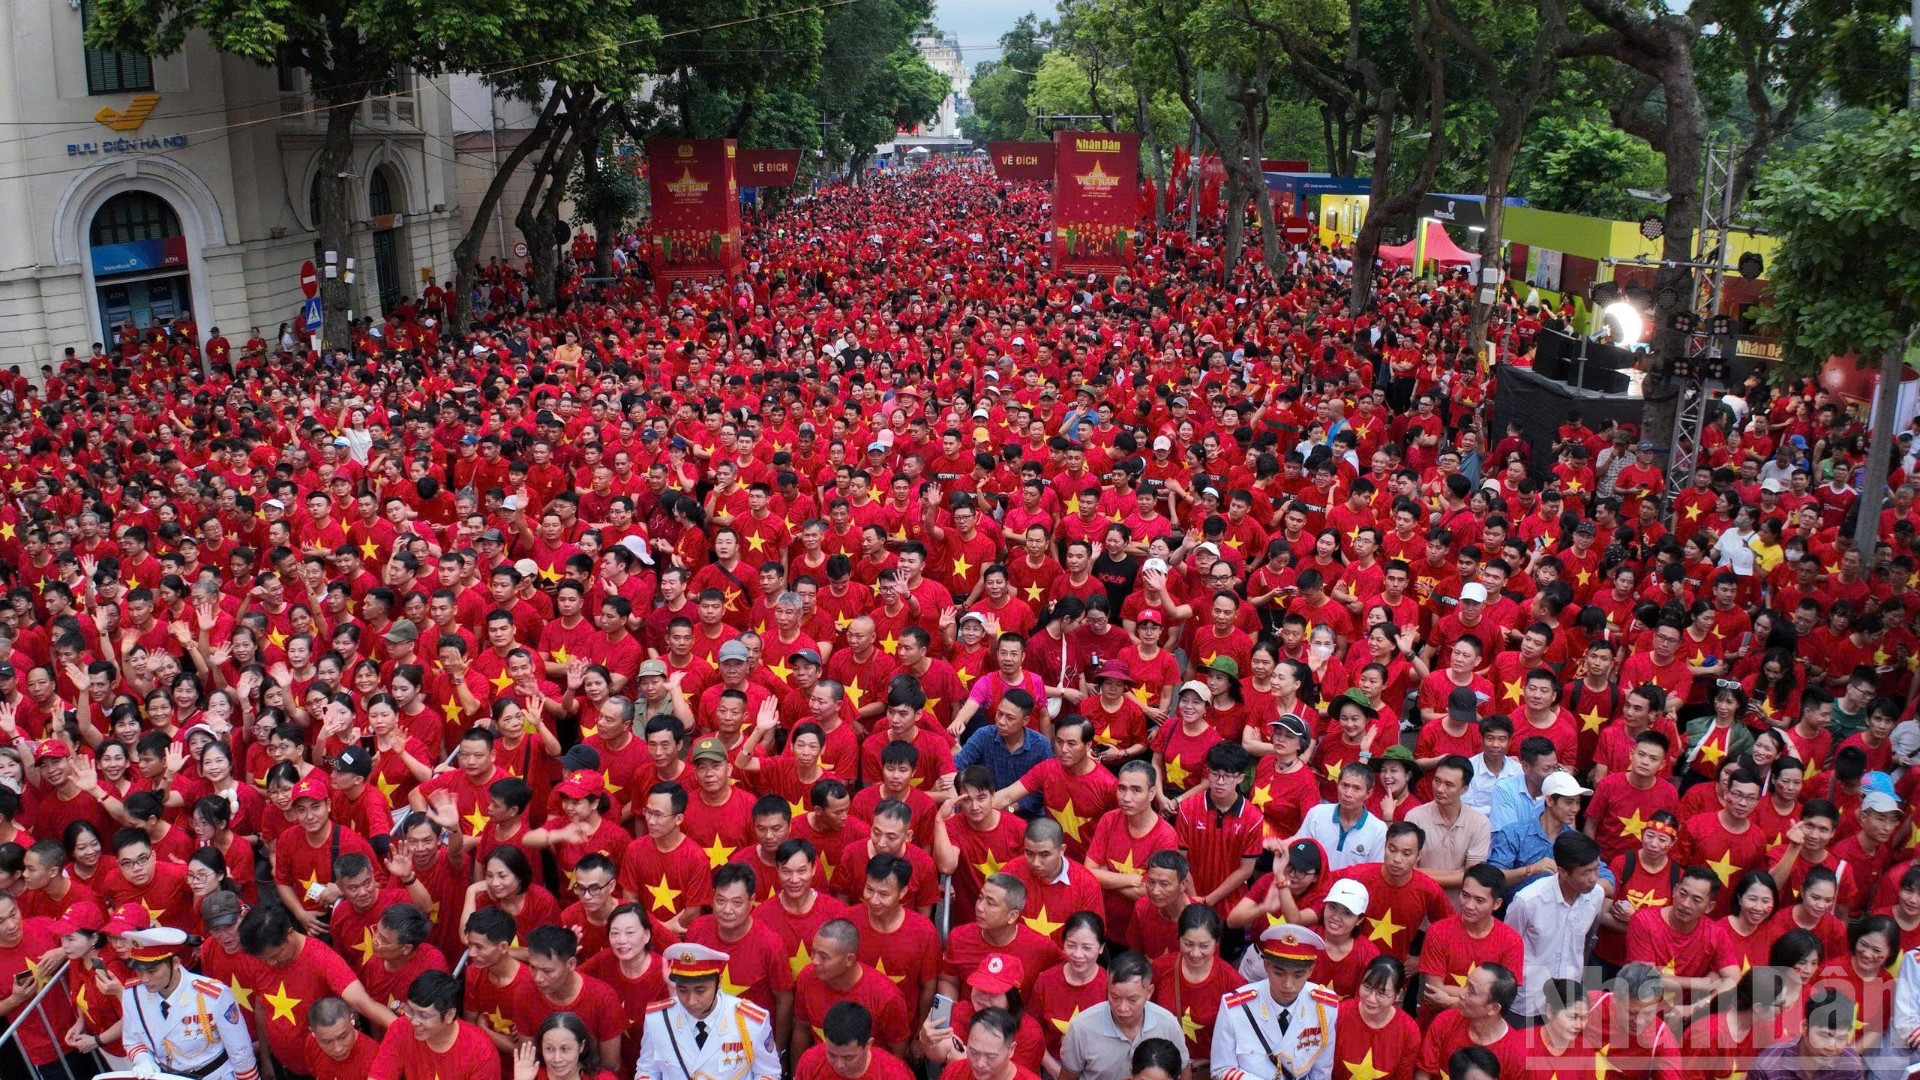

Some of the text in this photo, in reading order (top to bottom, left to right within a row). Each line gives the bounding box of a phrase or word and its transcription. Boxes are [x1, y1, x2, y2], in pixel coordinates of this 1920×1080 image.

[1076, 138, 1121, 150] Nhân Dân
[1016, 155, 1038, 166] ĐÍCH
[766, 161, 788, 172] ĐÍCH
[164, 256, 179, 264] ATM
[1736, 340, 1767, 356] Nhân
